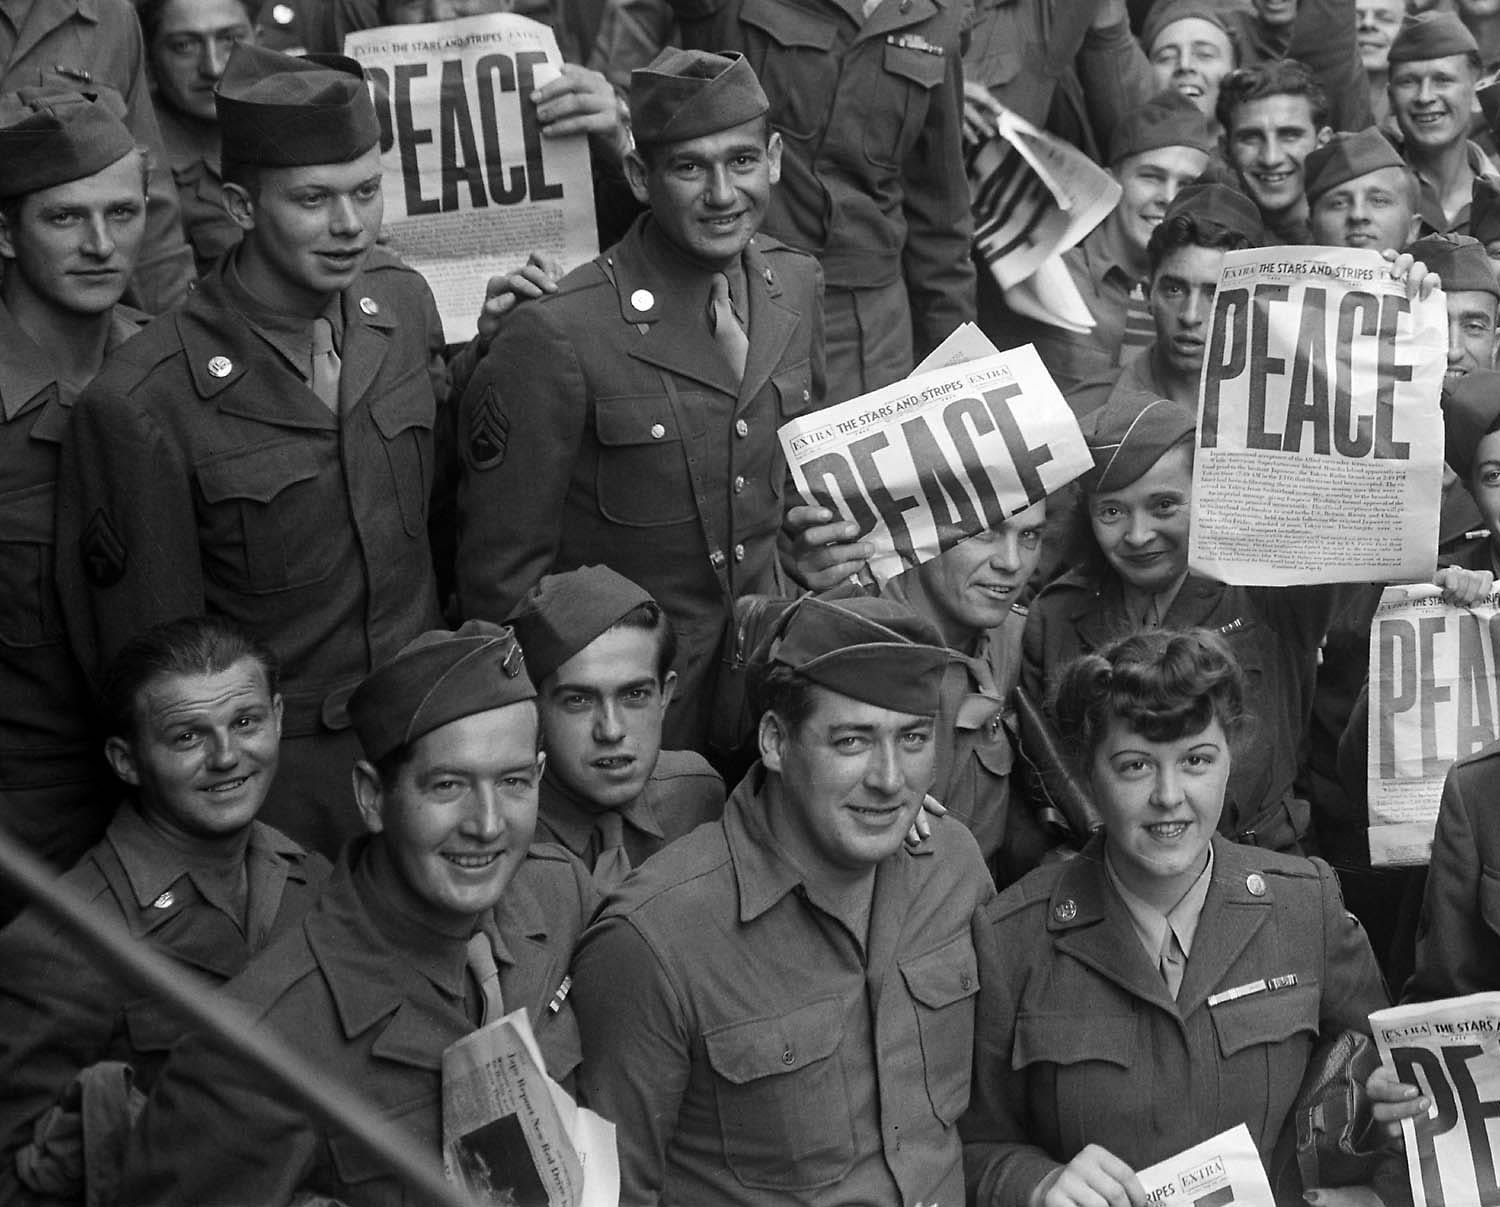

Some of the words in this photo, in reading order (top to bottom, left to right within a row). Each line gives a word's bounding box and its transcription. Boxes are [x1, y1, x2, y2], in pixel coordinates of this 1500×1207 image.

[392, 43, 408, 53] THE
[1258, 262, 1275, 274] THE
[1277, 263, 1307, 274] STARS
[1309, 264, 1333, 277] AND
[1334, 265, 1374, 281] STRIPES
[1200, 283, 1412, 460] PEACE
[791, 428, 833, 452] EXTRA
[836, 418, 859, 435] THE
[858, 405, 894, 426] STARS
[896, 394, 919, 412] AND
[920, 380, 964, 402] STRIPES
[968, 366, 1009, 385] EXTRA
[799, 382, 1054, 569] PEACE
[1385, 1023, 1428, 1041] EXTRA
[1433, 1022, 1454, 1034] THE
[1456, 1019, 1493, 1034] STARS
[1181, 1161, 1223, 1188] EXTRA
